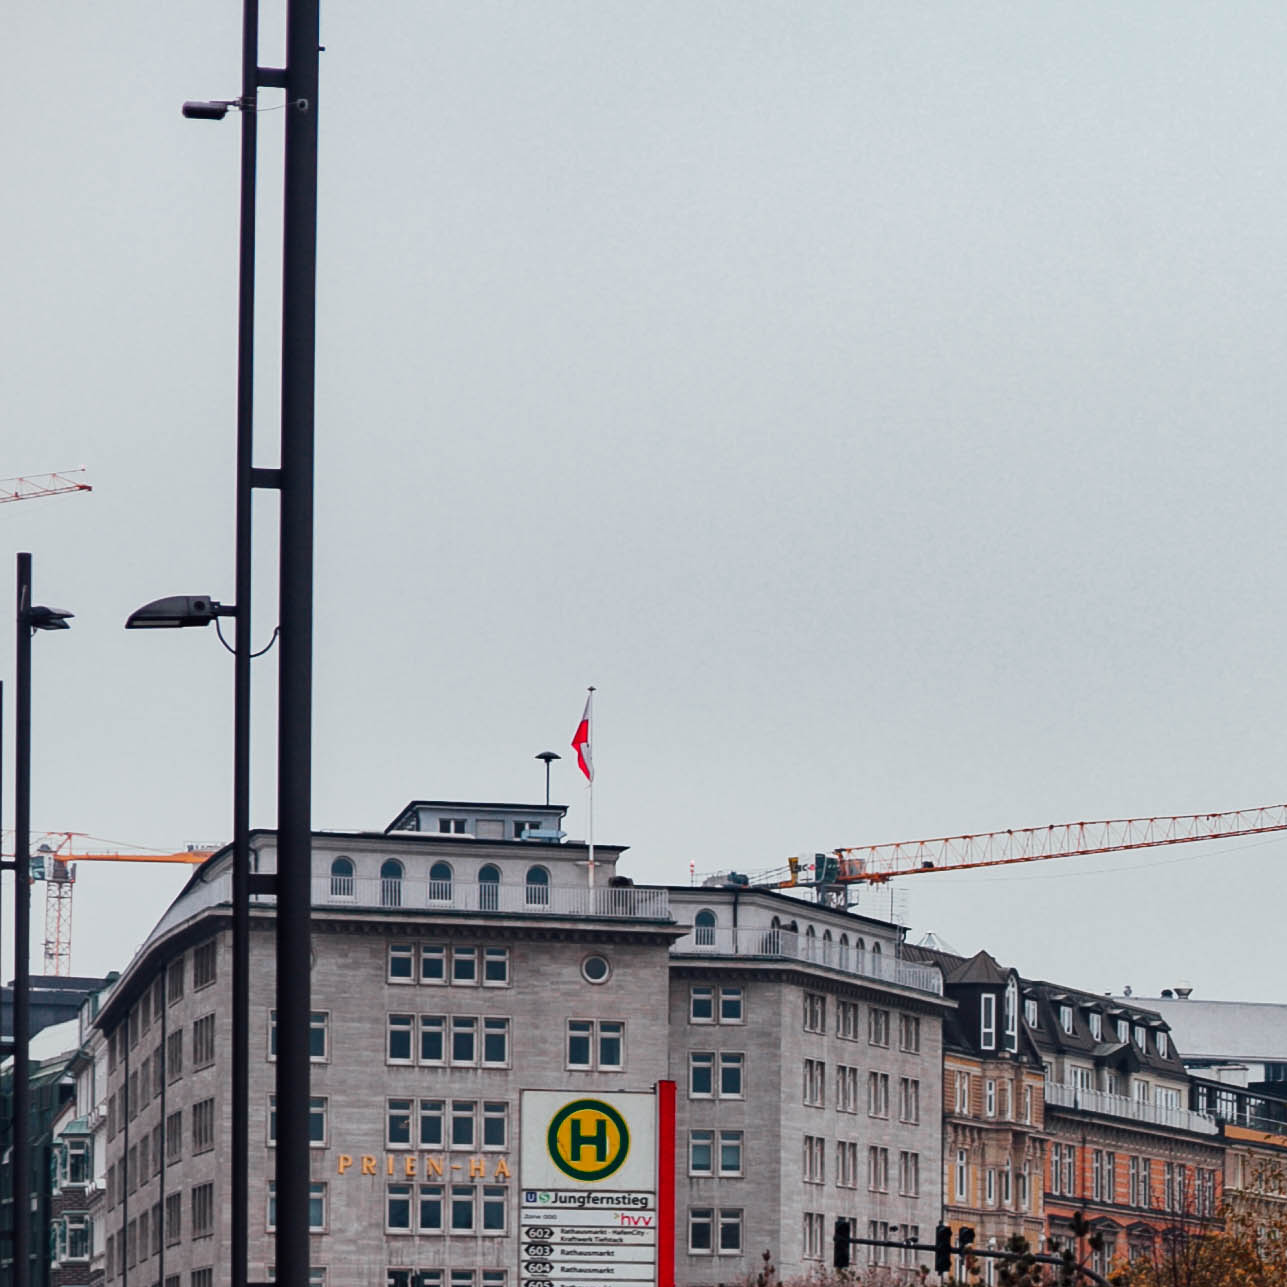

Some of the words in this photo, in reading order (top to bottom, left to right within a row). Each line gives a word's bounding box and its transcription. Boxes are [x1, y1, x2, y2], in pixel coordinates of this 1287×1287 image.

[571, 1119, 607, 1162] H
[551, 1191, 649, 1208] Jungfernstieg
[621, 1213, 652, 1226] hvv
[529, 1228, 551, 1238] 602
[529, 1246, 550, 1256] 603
[560, 1249, 614, 1257] Rathausmarkt
[528, 1263, 550, 1273] 604
[560, 1266, 614, 1274] Rathausmarkt
